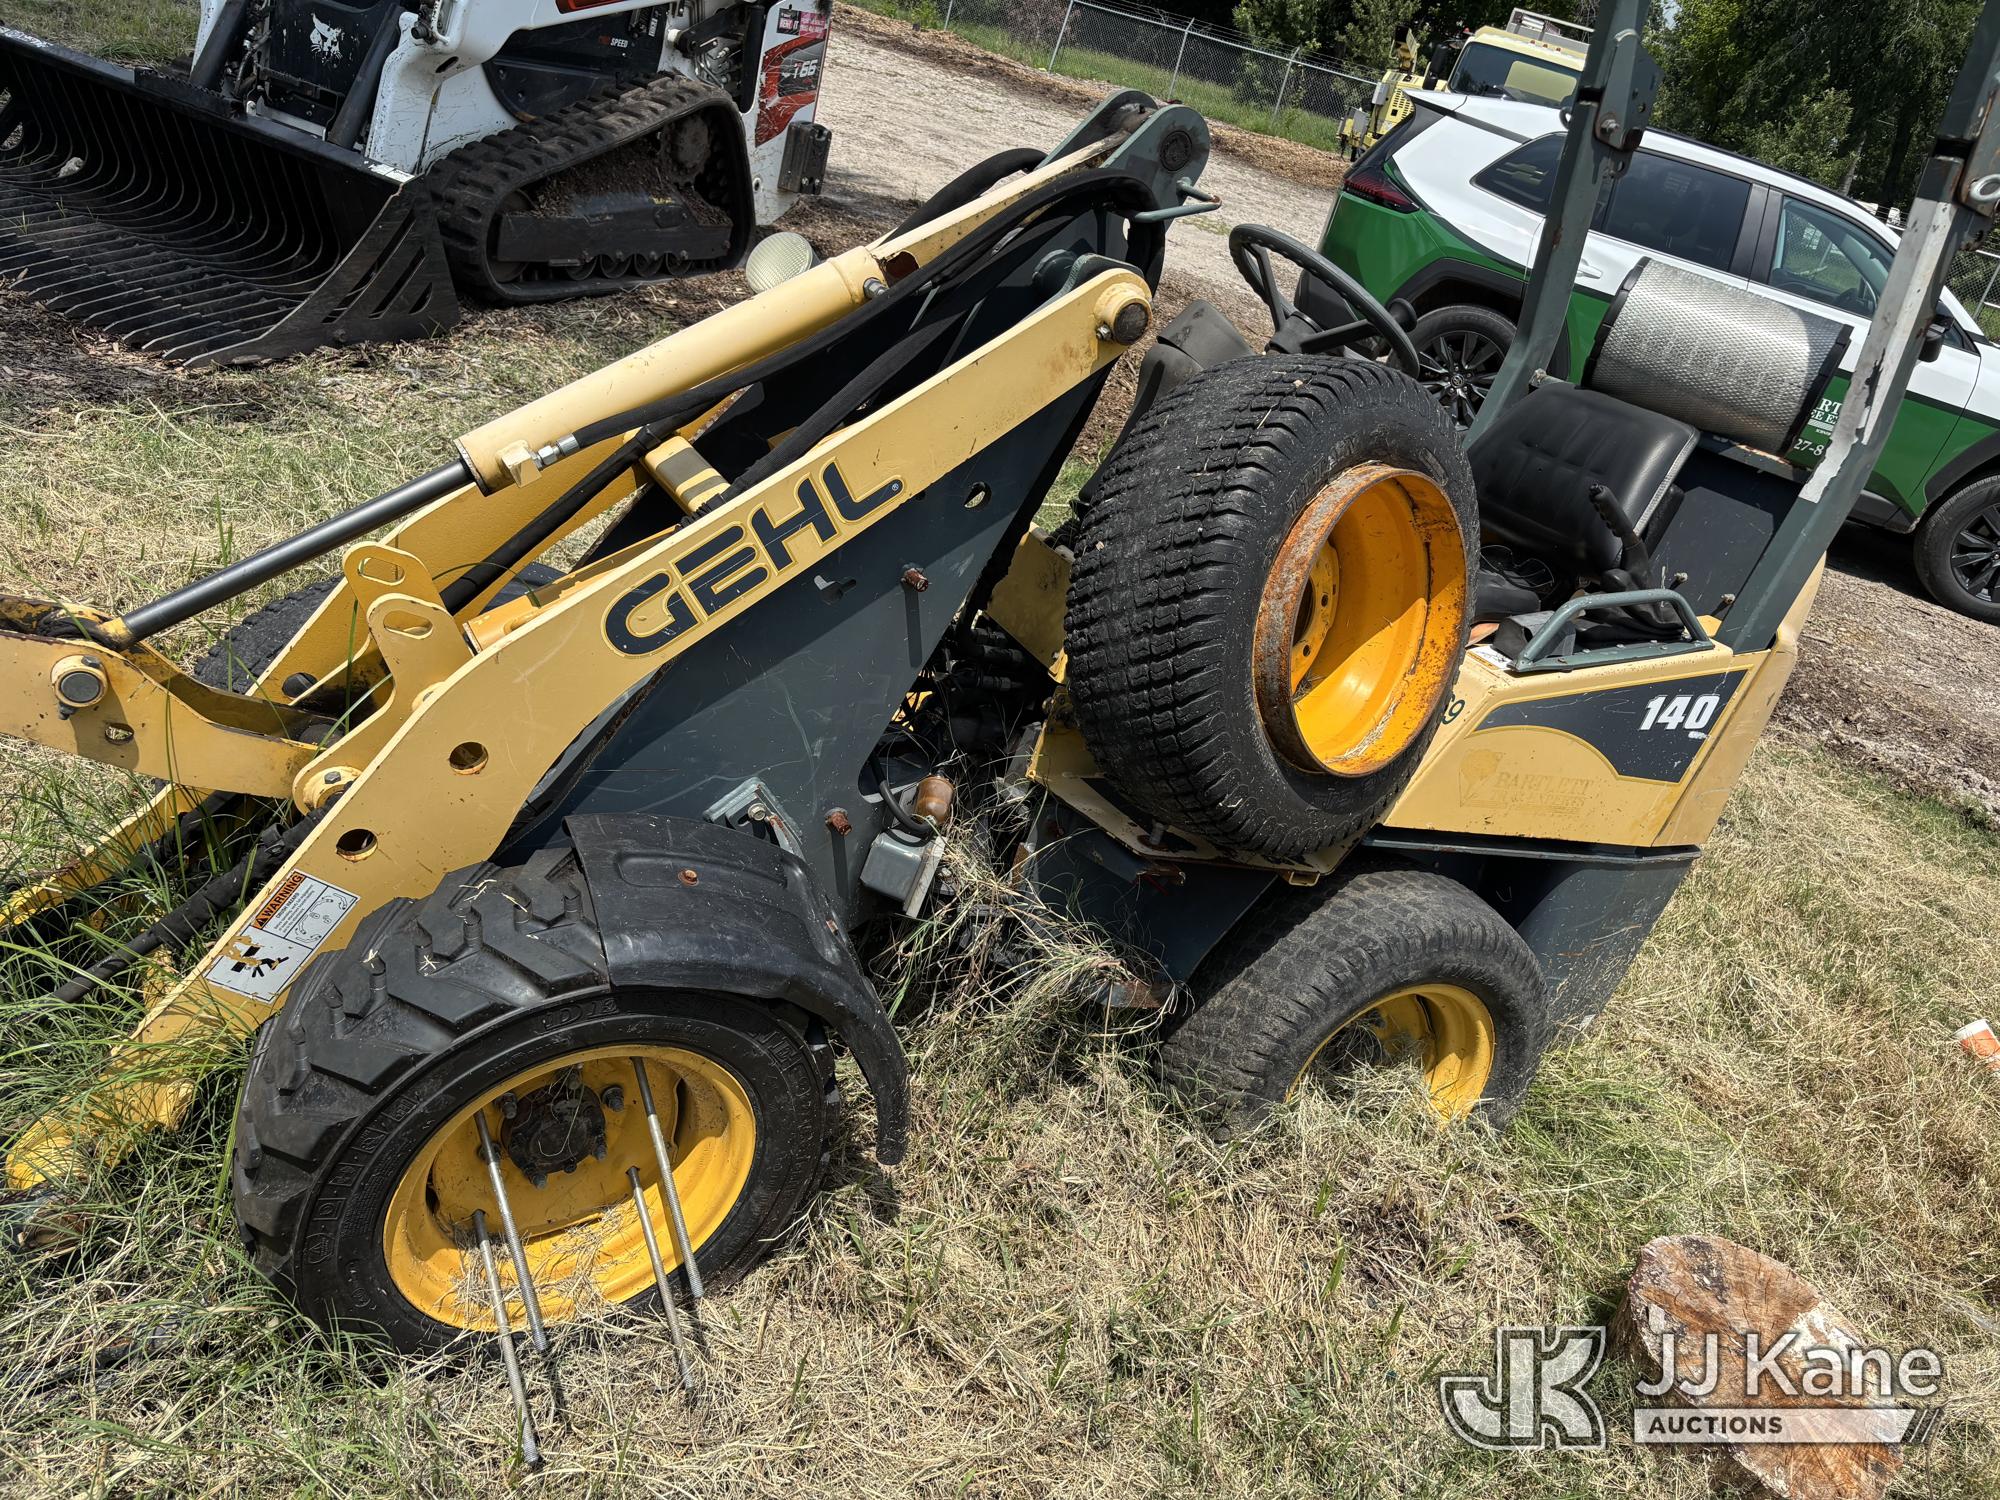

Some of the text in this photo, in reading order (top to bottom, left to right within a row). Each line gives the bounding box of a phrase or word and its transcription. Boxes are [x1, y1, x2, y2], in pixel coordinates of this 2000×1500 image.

[611, 38, 628, 48] SPEED
[1816, 398, 1842, 415] RT
[600, 456, 905, 658] GEHL
[1638, 694, 1720, 731] 140
[264, 873, 303, 918] WARNING
